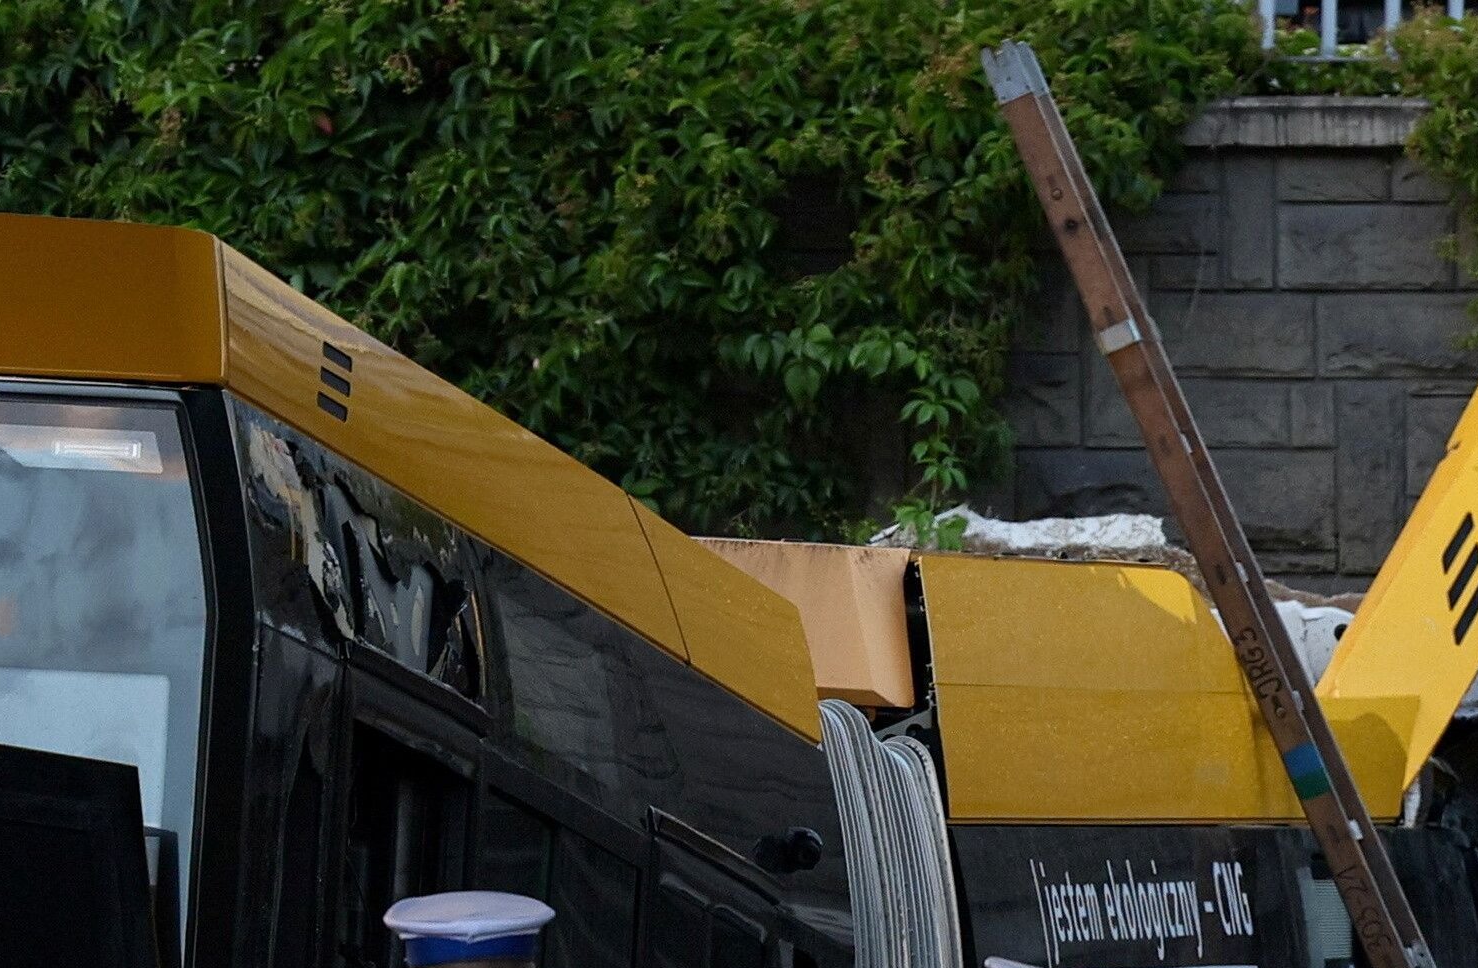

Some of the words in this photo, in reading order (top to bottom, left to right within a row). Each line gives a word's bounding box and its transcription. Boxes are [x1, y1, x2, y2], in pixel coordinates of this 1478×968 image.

[1037, 860, 1104, 966] jestem
[1103, 858, 1204, 961] ekologiczny
[1212, 860, 1254, 937] CNG
